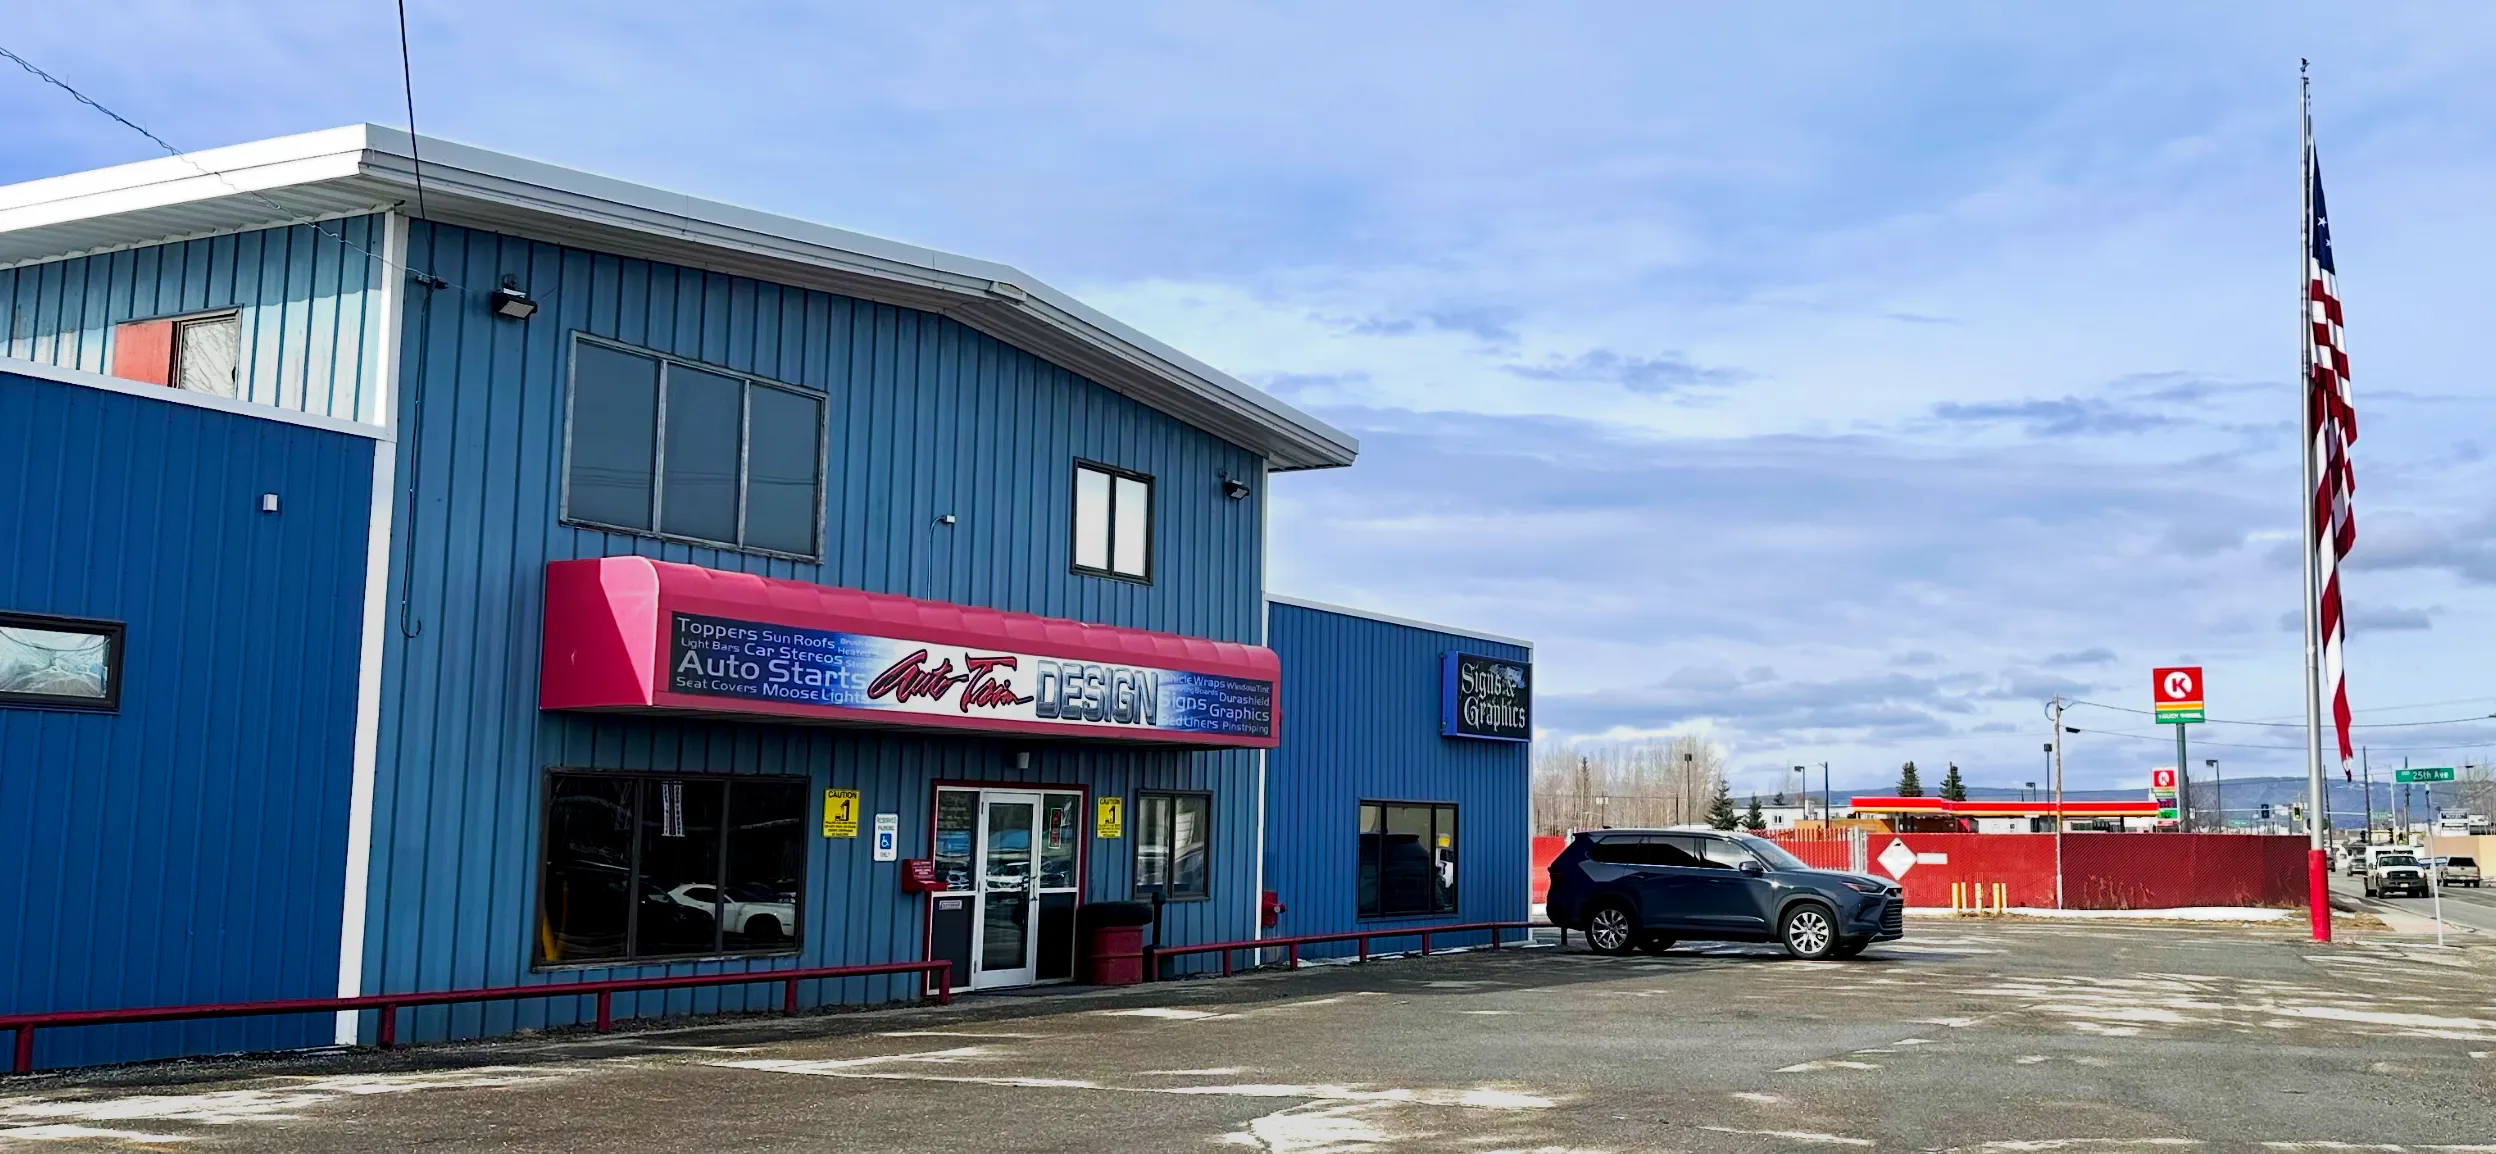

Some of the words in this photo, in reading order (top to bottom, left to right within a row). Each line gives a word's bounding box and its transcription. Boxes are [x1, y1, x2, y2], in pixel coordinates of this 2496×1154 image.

[677, 617, 758, 641] Toppers
[762, 631, 791, 645] Sun
[793, 634, 835, 649] Roofs
[681, 636, 710, 650] Light
[712, 641, 740, 653] Bars
[744, 643, 774, 658] Car
[779, 646, 843, 666] Stereos
[677, 649, 760, 680] Auto
[768, 659, 867, 690] Starts
[1460, 662, 1502, 700] Signs
[676, 676, 708, 689] Seat
[711, 679, 757, 694] Covers
[762, 683, 819, 700] Moose
[821, 689, 871, 705] Lights
[867, 649, 969, 704] Auto
[960, 652, 1034, 713] Trim
[1035, 659, 1158, 725] DESIGN
[1193, 676, 1225, 689] Wraps
[1160, 692, 1207, 712] Signs
[1219, 692, 1270, 707] Durashield
[1209, 704, 1270, 722] Graphics
[1464, 696, 1526, 732] Graphics
[1222, 721, 1269, 735] Pinstriping
[2412, 771, 2432, 780] 25th
[2433, 770, 2449, 779] Ave
[828, 791, 857, 799] CAUTION
